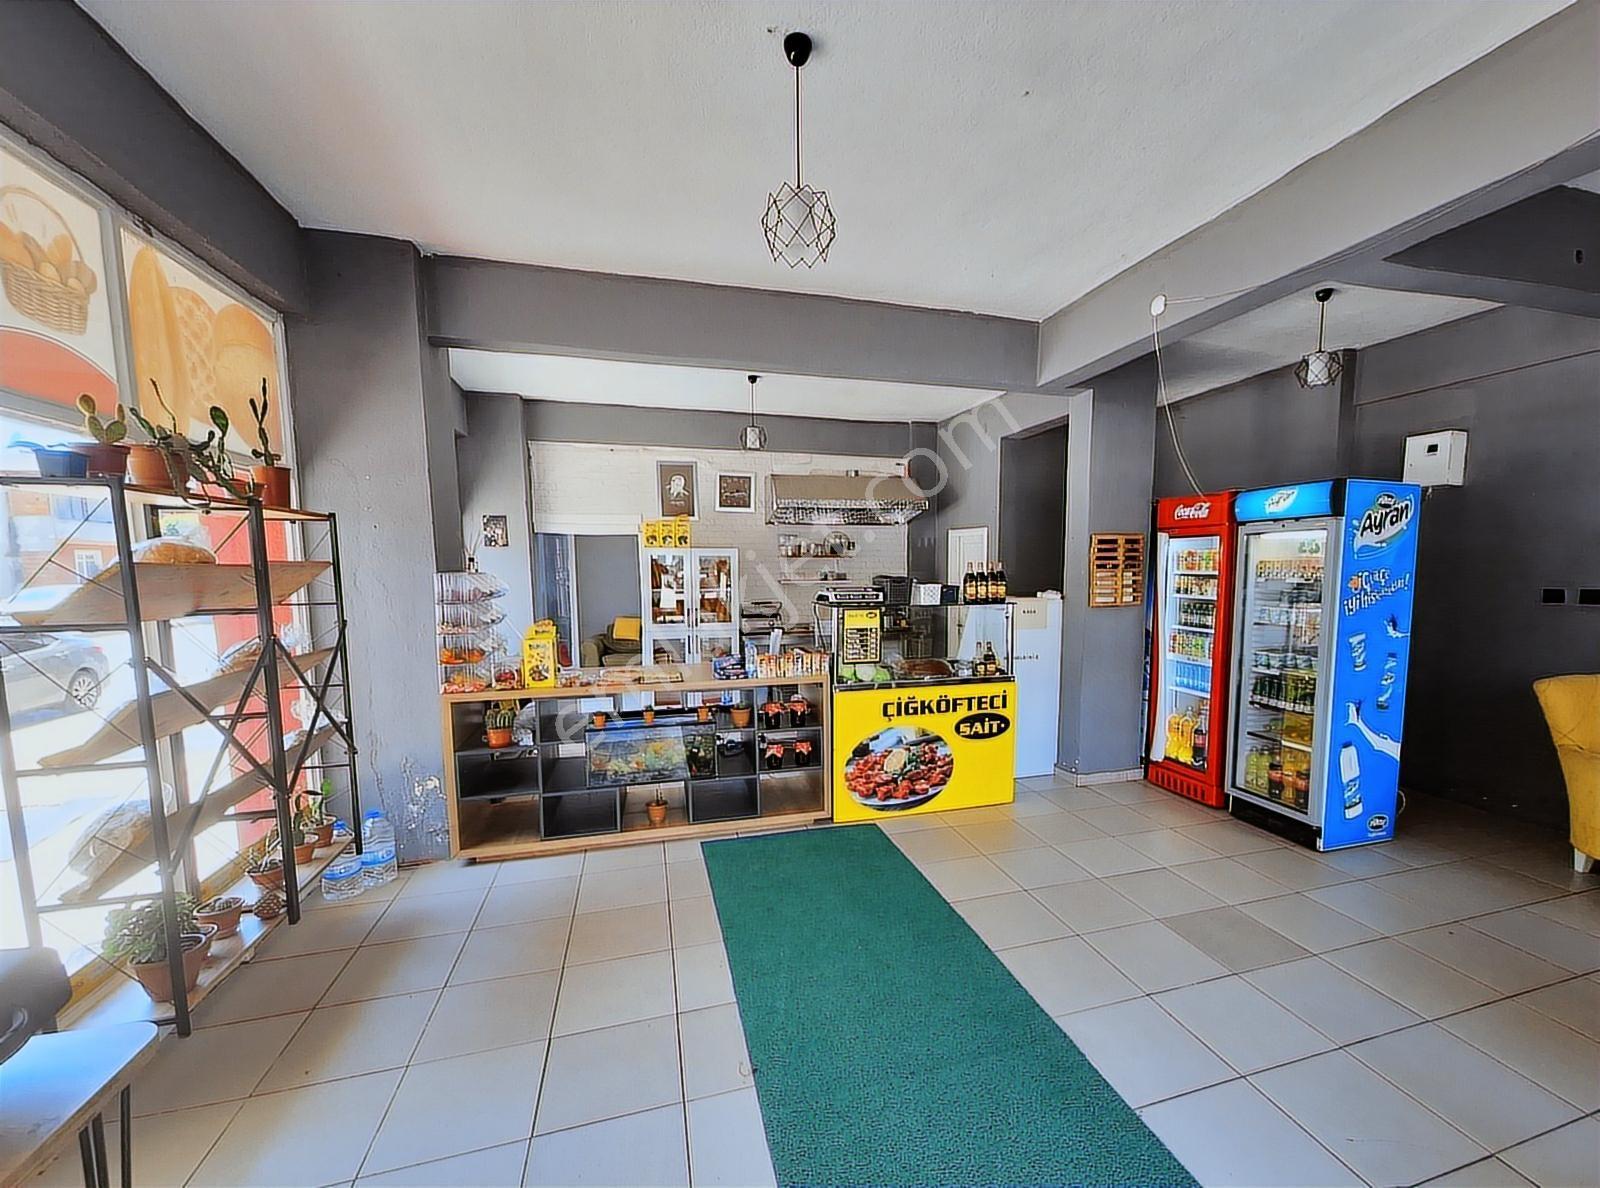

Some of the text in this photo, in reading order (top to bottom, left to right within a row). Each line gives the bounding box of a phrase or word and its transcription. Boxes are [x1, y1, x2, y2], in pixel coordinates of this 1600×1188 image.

[1360, 500, 1410, 538] Ayran
[882, 689, 1008, 722] ÇİĞKÖFTECİ
[959, 717, 1001, 736] SAİT
